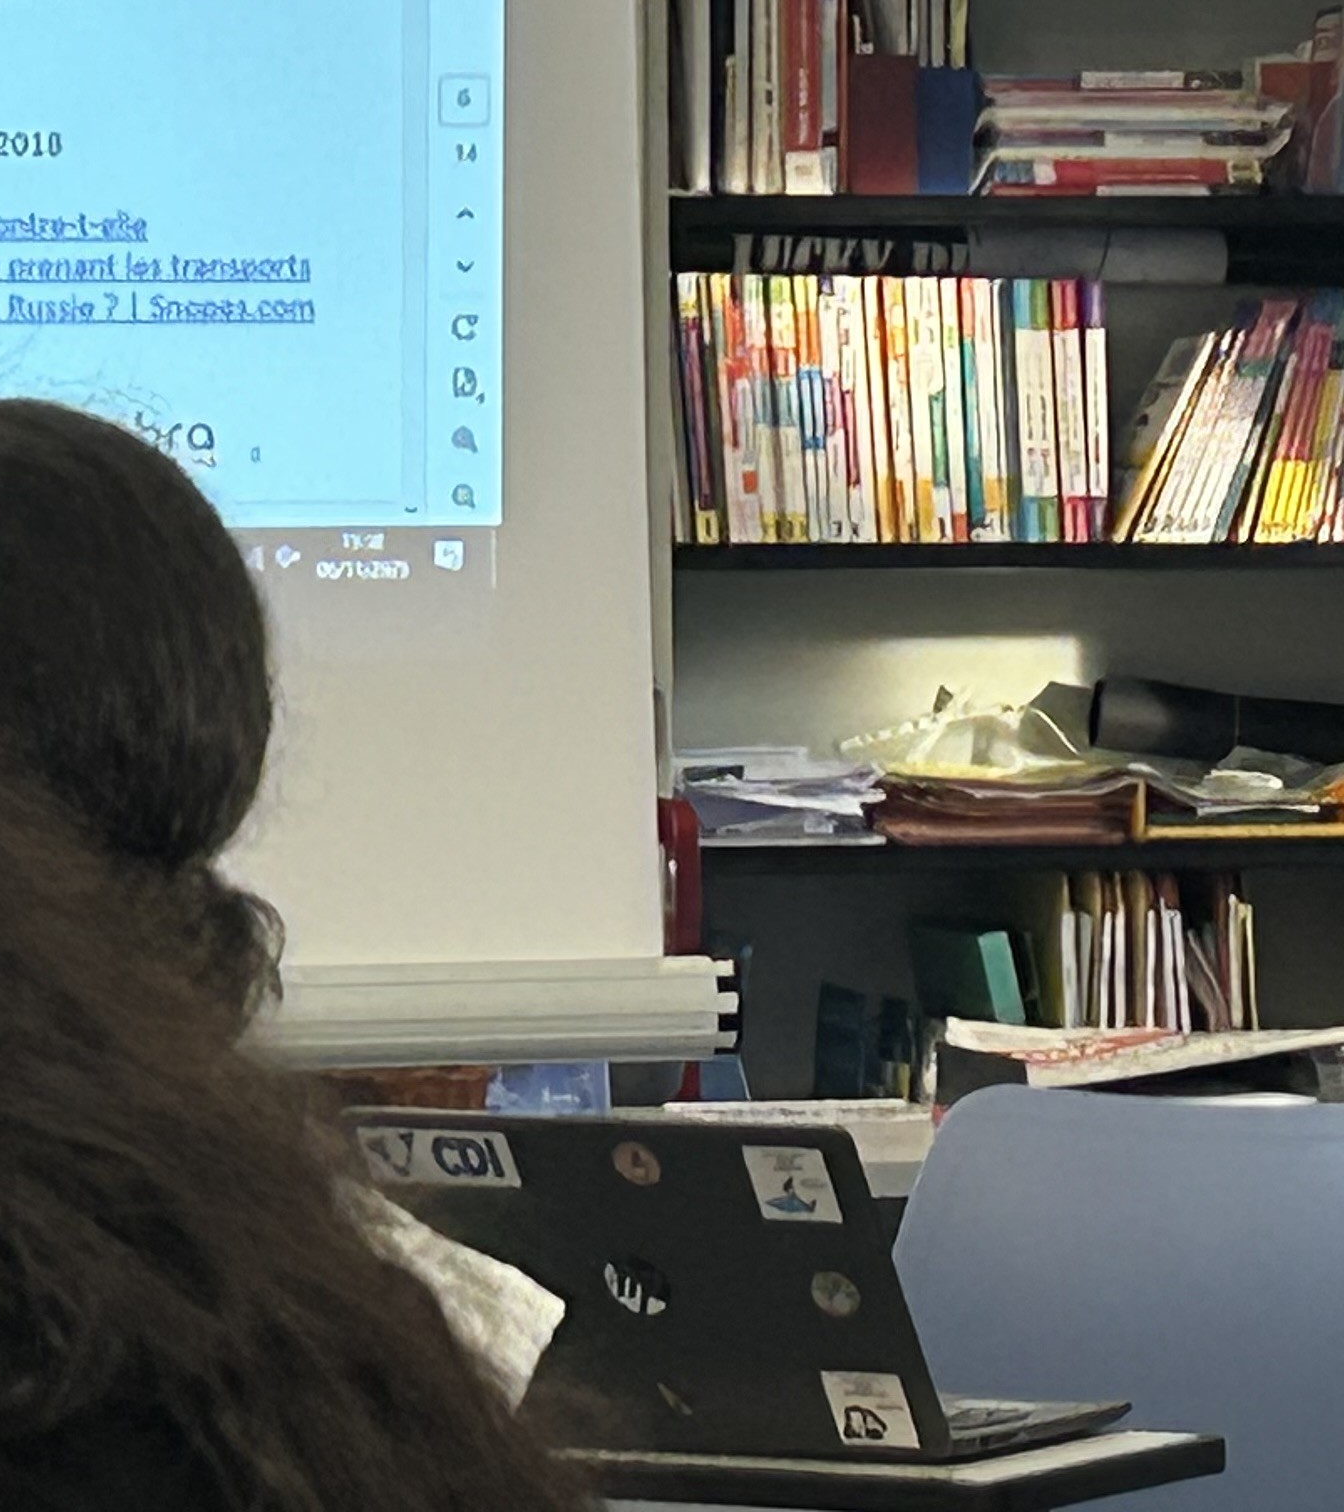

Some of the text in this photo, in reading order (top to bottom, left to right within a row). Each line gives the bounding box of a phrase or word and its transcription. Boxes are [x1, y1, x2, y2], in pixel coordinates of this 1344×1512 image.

[8, 257, 116, 283] prenant
[126, 251, 161, 280] les
[171, 255, 311, 283] transports
[7, 294, 96, 323] Russie
[431, 1135, 506, 1178] CDI
